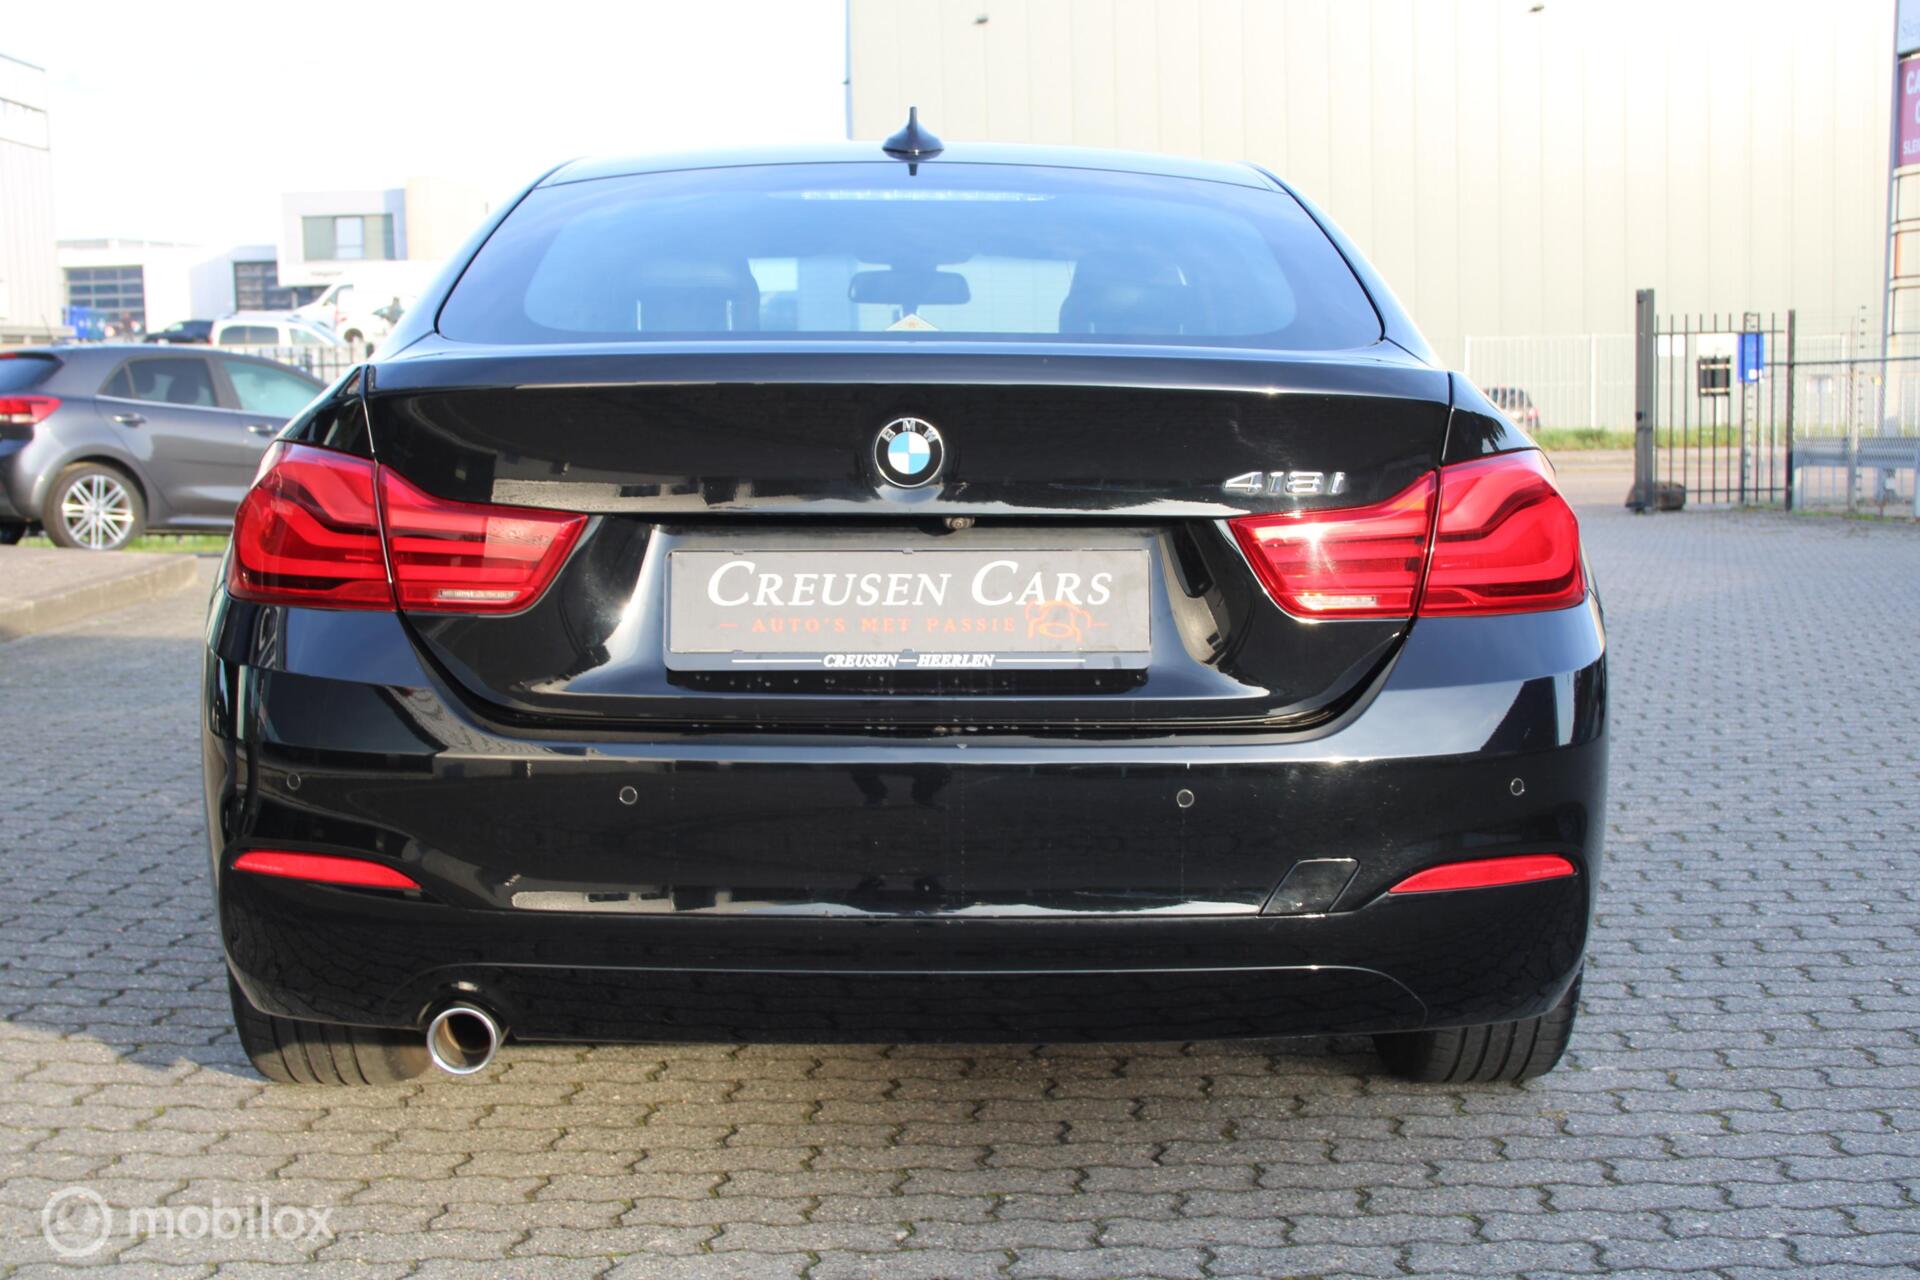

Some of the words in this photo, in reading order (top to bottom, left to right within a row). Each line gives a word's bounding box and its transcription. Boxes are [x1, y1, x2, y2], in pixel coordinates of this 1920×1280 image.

[880, 419, 938, 443] BMW
[1222, 471, 1346, 496] 418i
[707, 560, 952, 607] CREUSEN
[971, 559, 1113, 606] CARS
[752, 616, 847, 634] AUTO'S
[860, 616, 912, 633] MET
[927, 616, 1016, 633] PASSIE
[823, 653, 900, 668] CREUSEN
[916, 653, 996, 668] HEERLEN
